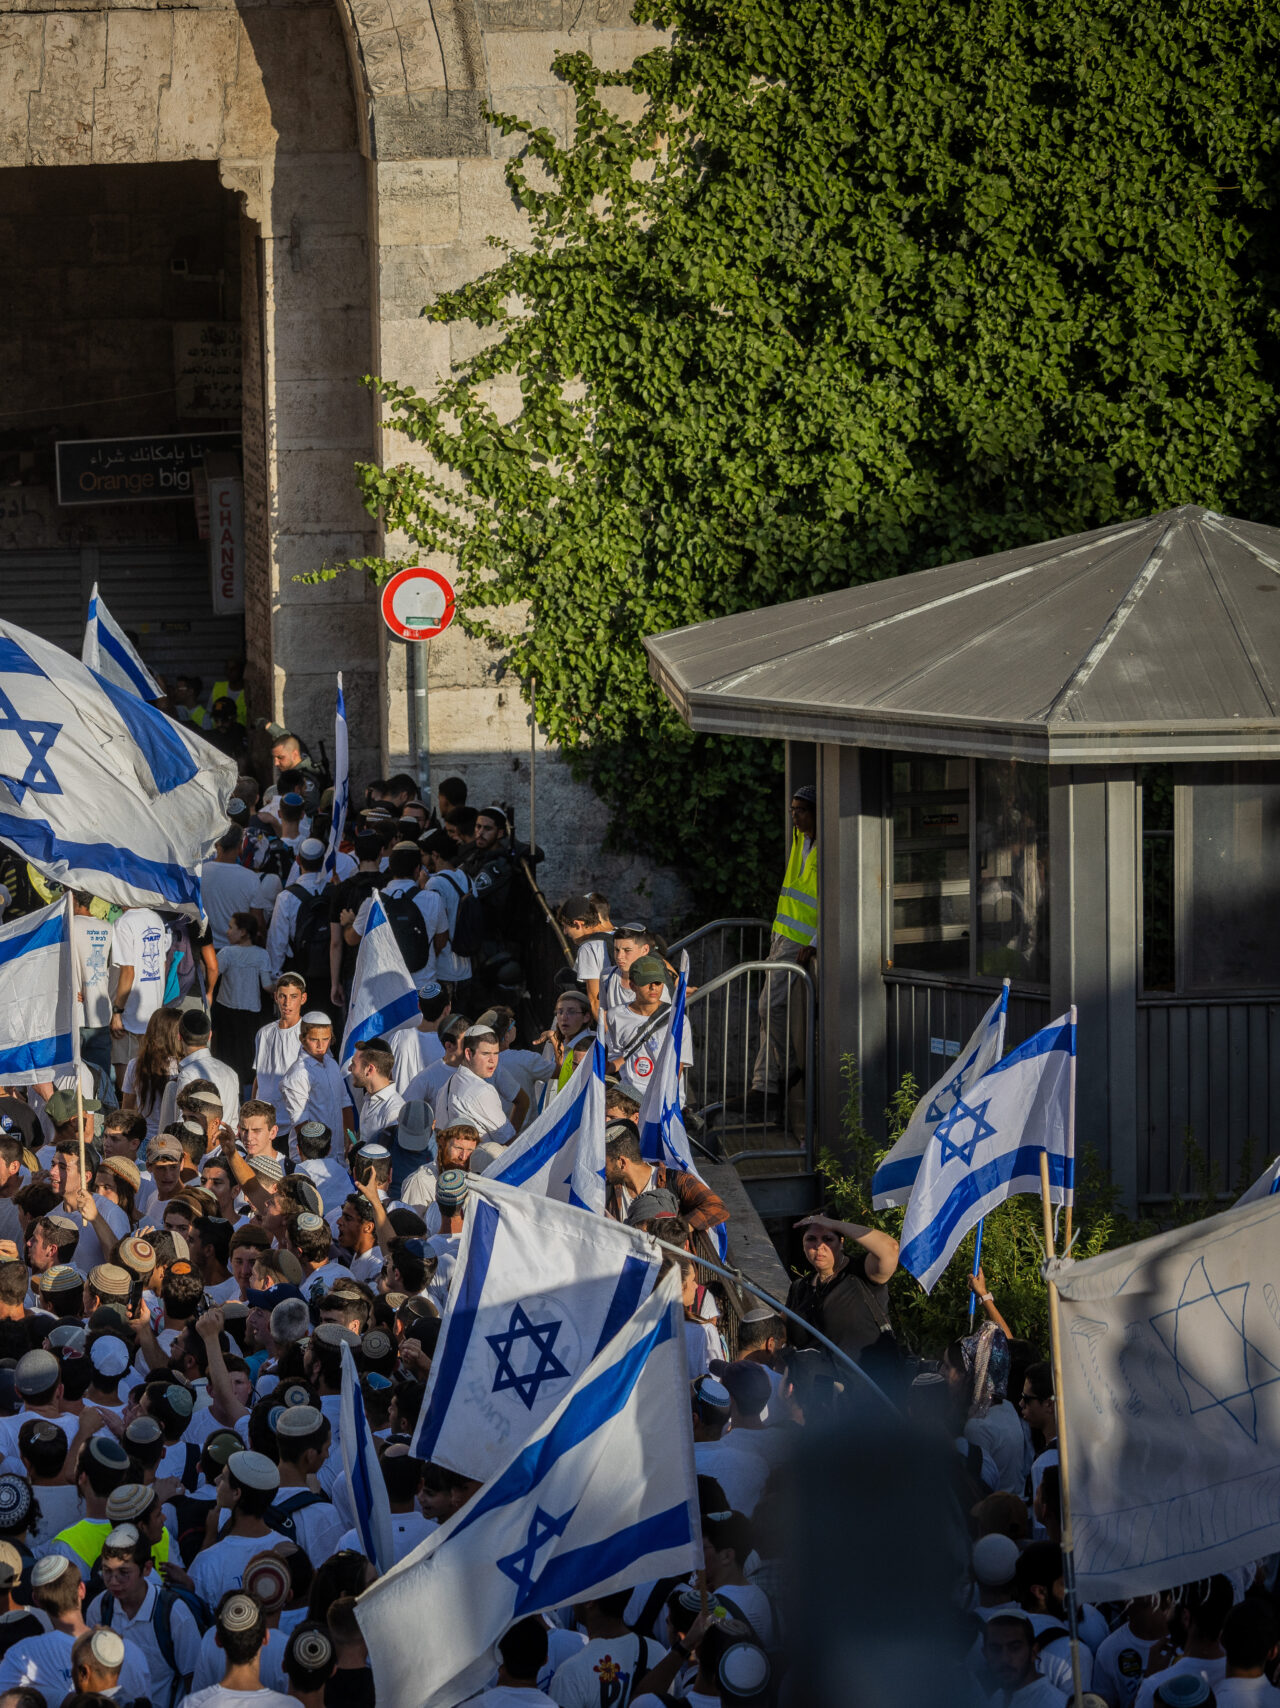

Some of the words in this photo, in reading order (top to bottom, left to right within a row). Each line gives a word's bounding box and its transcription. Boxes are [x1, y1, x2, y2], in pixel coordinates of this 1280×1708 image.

[89, 448, 125, 469] شراء
[79, 471, 155, 494] Orange
[159, 467, 191, 490] big
[218, 491, 235, 599] CHANGE
